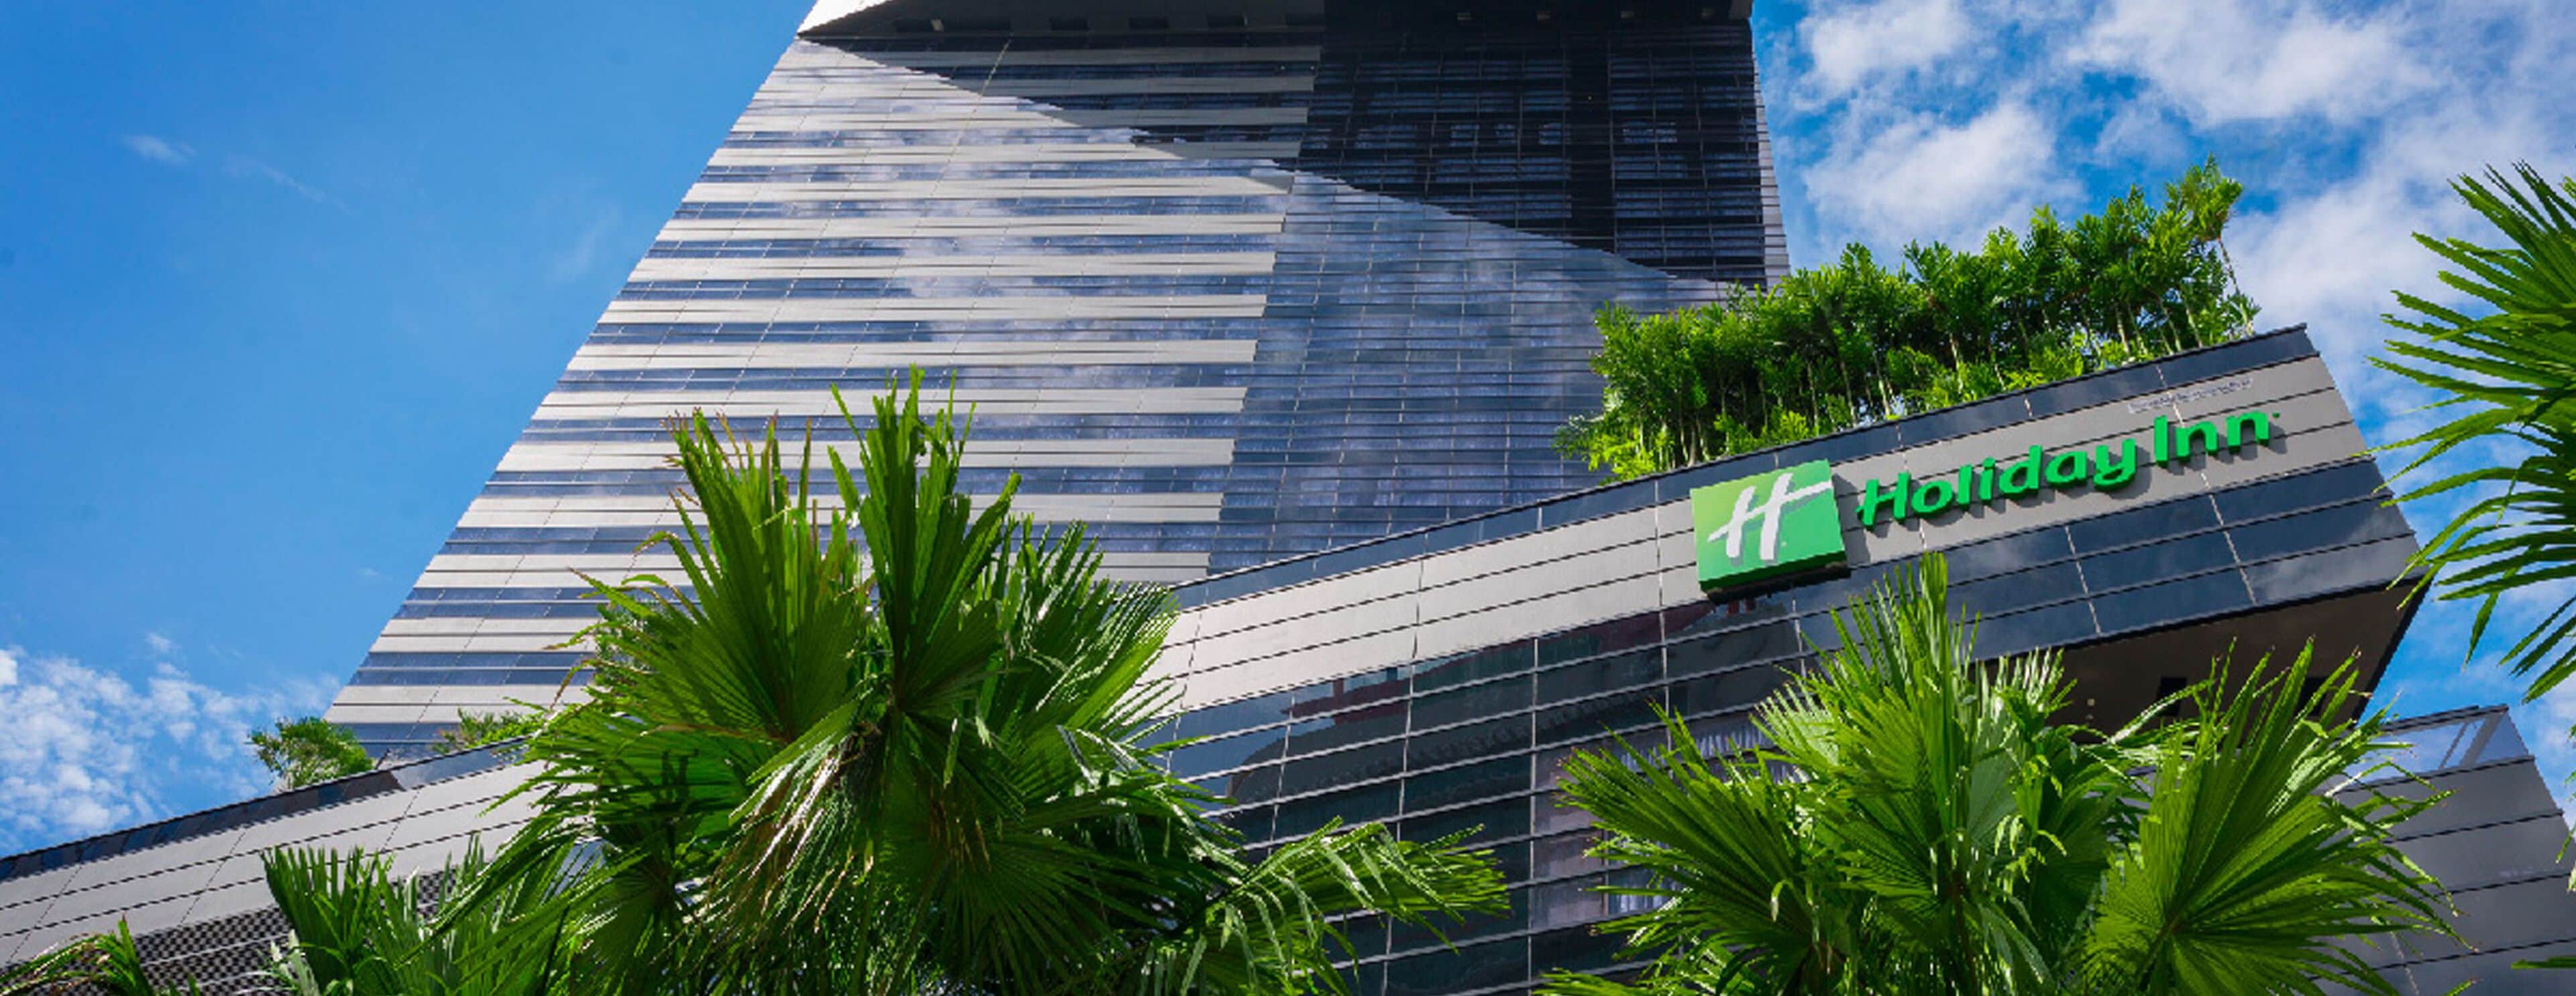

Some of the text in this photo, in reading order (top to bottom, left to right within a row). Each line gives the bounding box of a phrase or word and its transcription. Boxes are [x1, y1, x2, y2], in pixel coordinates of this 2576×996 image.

[1708, 472, 1833, 560] H
[1854, 411, 2271, 528] Holiday Inn
